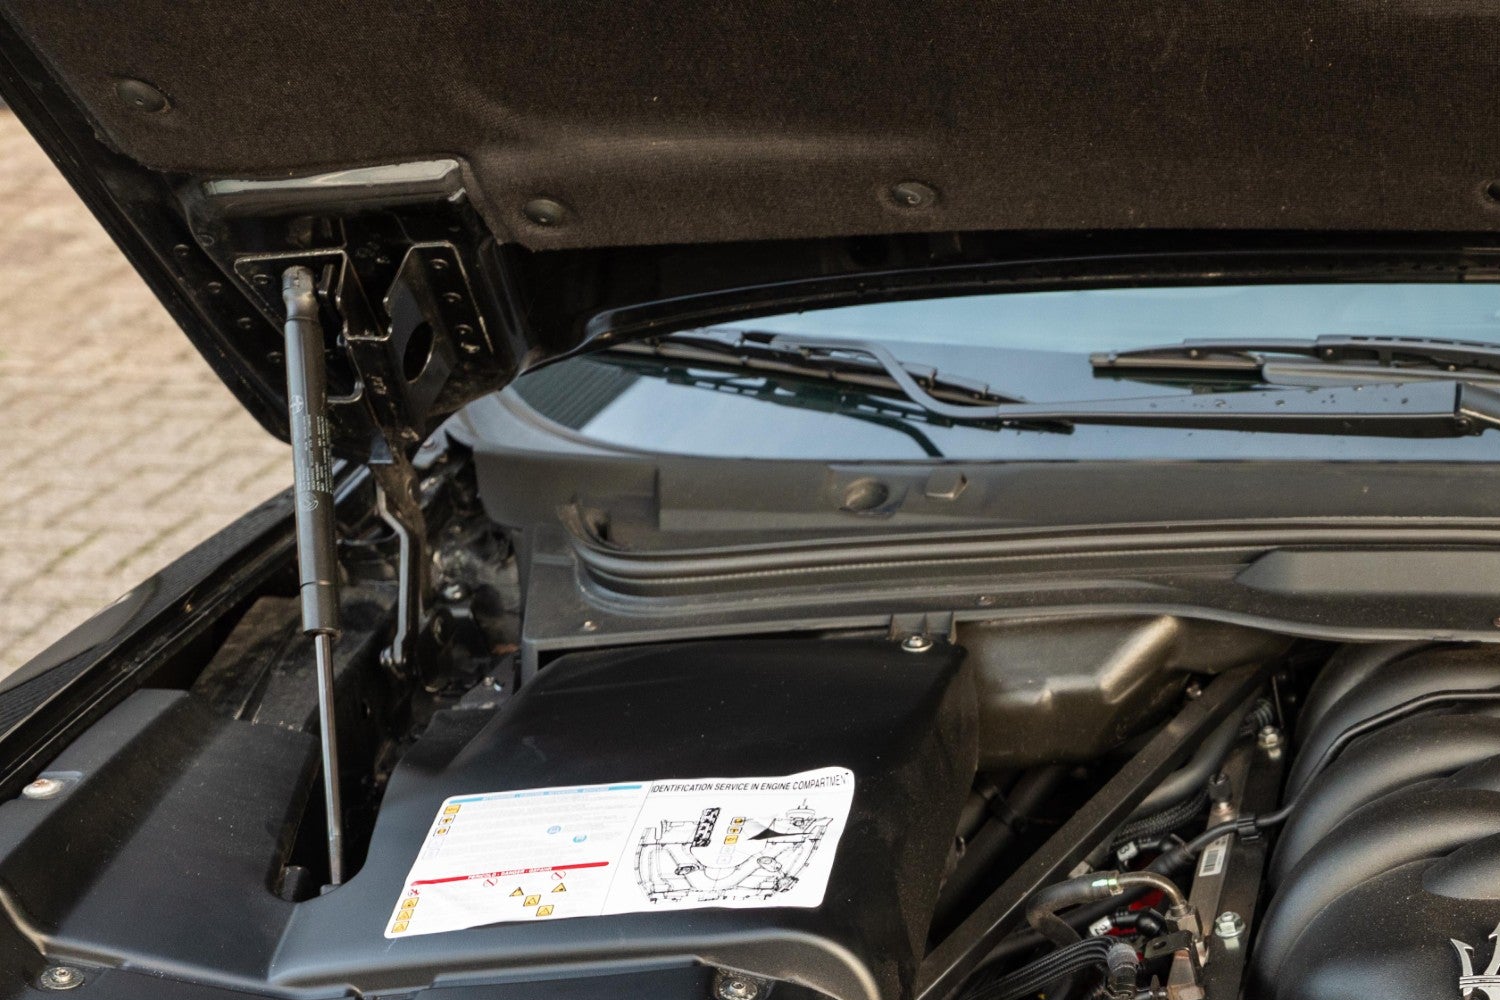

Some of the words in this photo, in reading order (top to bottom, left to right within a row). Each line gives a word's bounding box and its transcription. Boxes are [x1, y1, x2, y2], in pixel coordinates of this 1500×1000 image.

[651, 783, 712, 793] IDENTIFICATION
[714, 782, 749, 791] SERVICE
[760, 782, 792, 790] ENGINE
